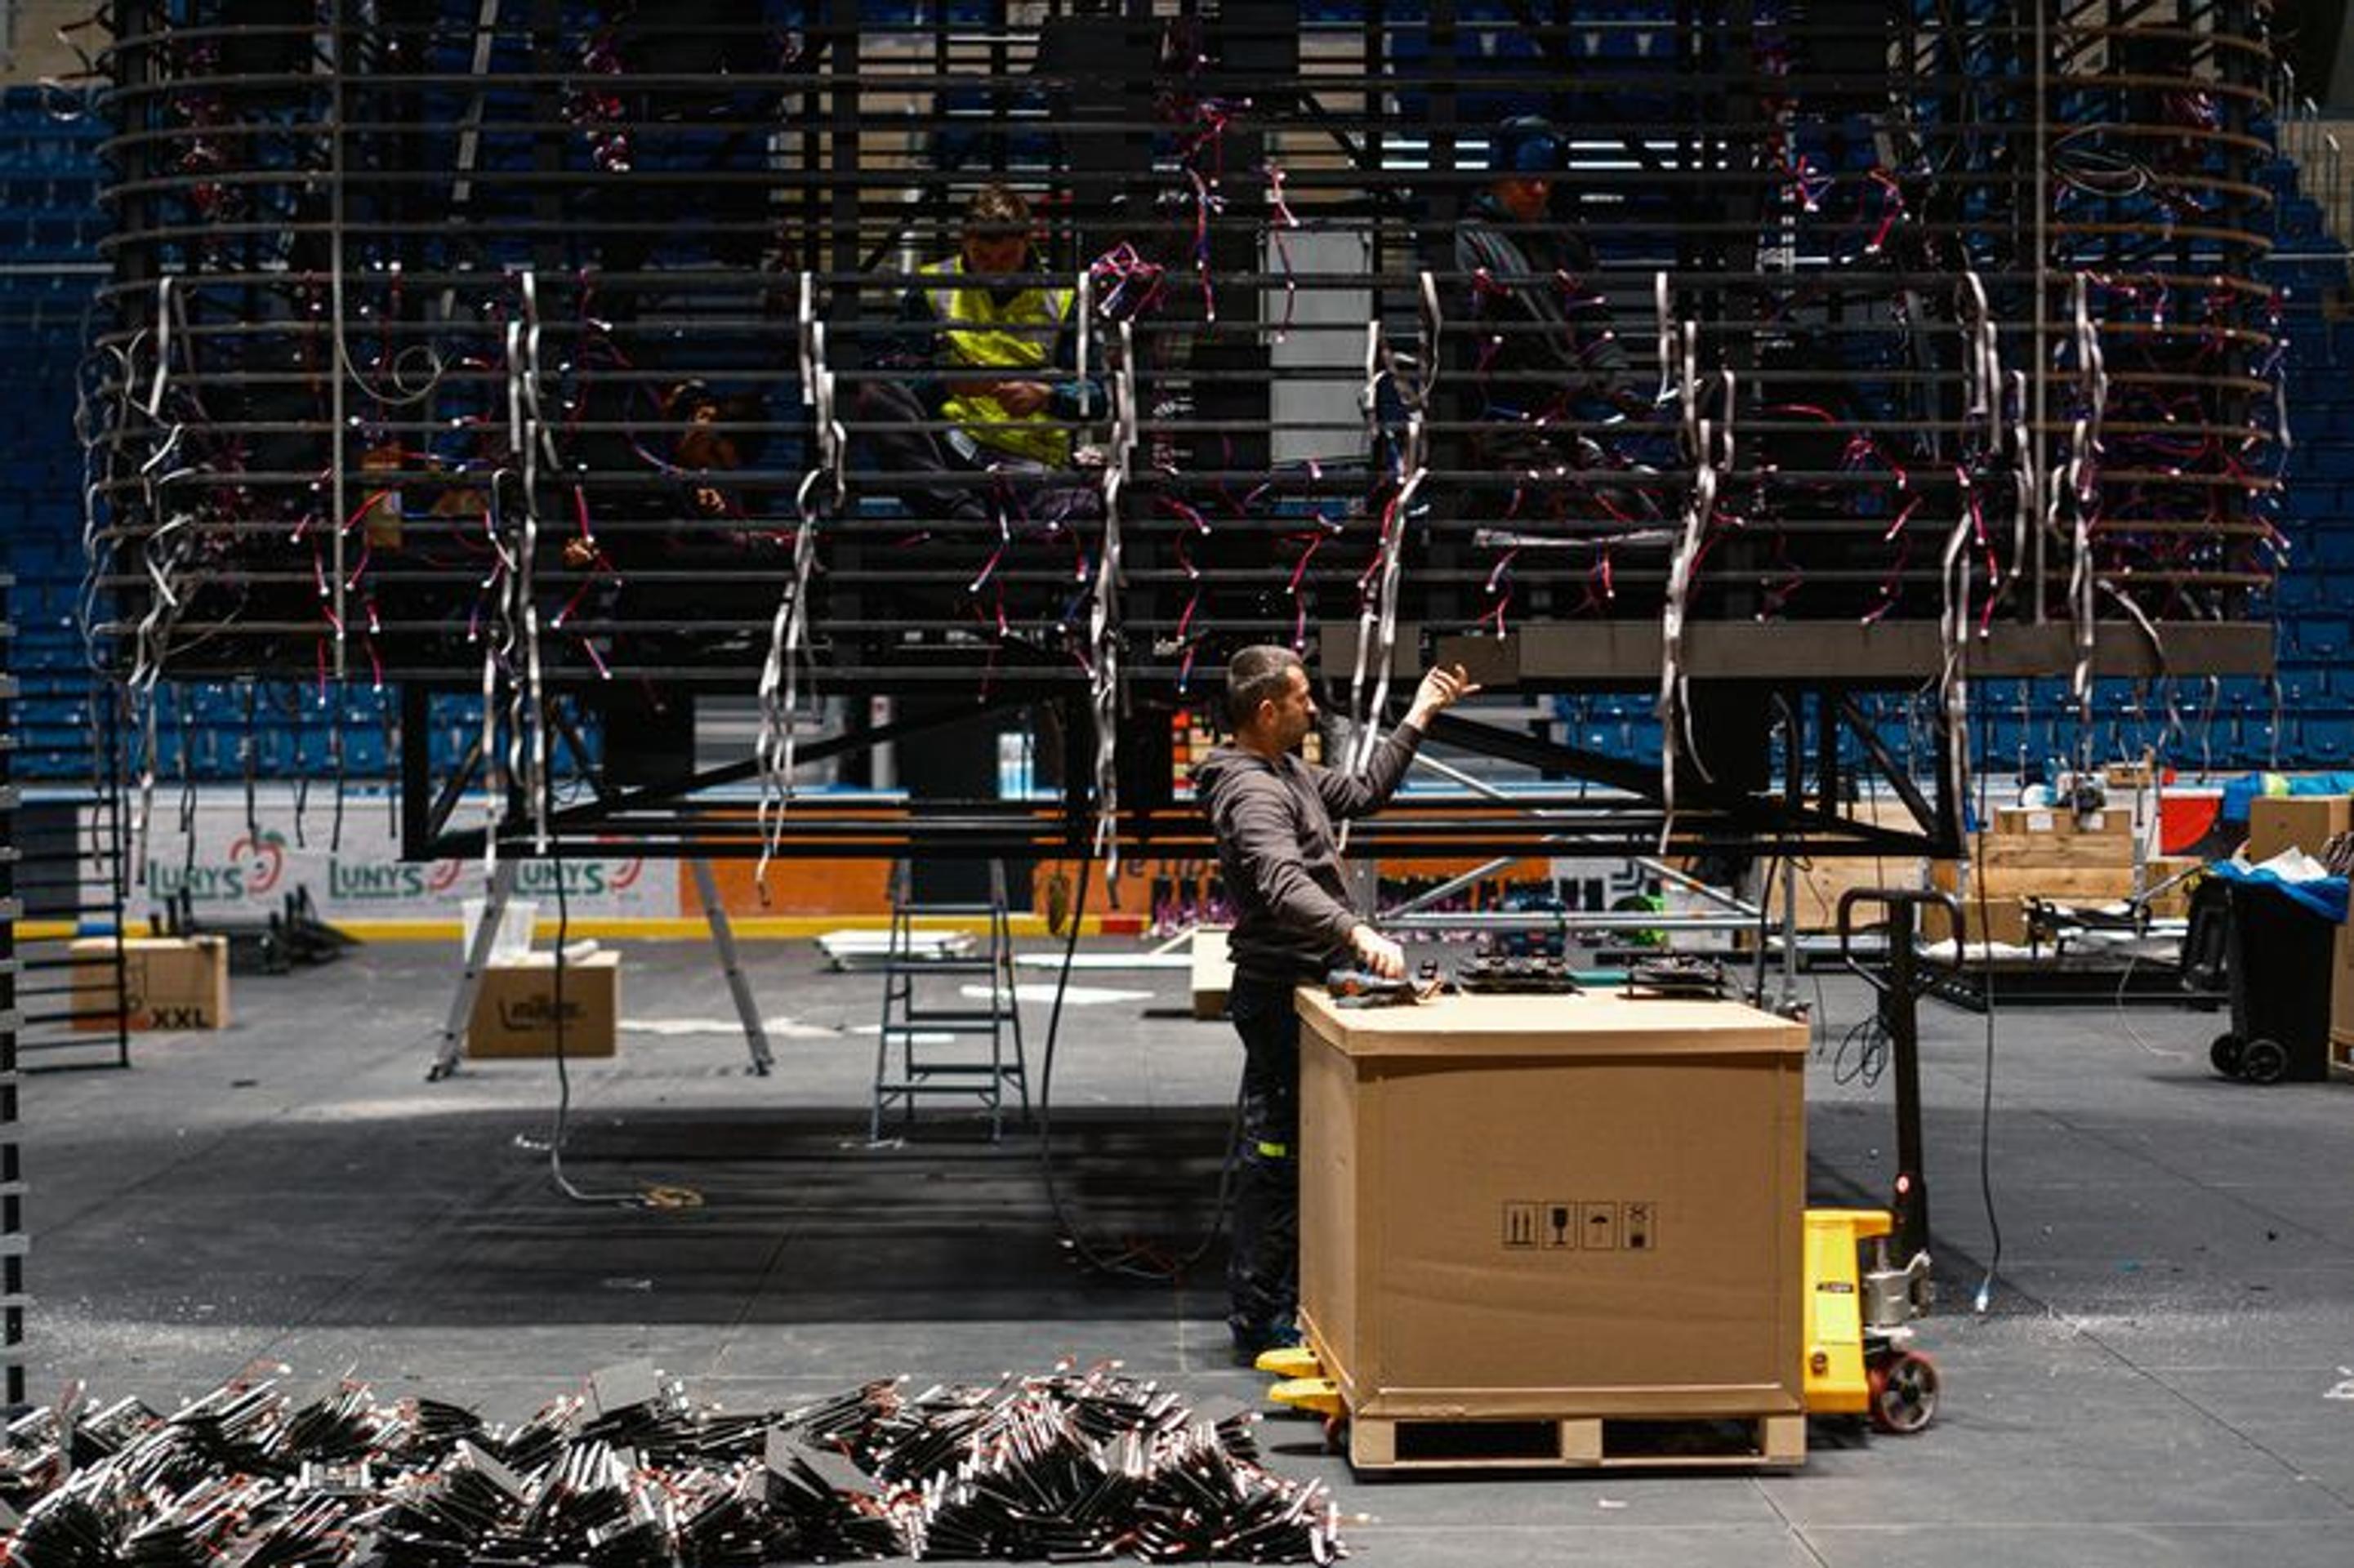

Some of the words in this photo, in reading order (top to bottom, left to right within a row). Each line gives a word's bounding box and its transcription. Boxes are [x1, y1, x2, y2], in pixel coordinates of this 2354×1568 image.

[149, 860, 243, 899] LUNYS
[330, 858, 423, 898] LUNYS
[152, 1007, 210, 1028] XXL
